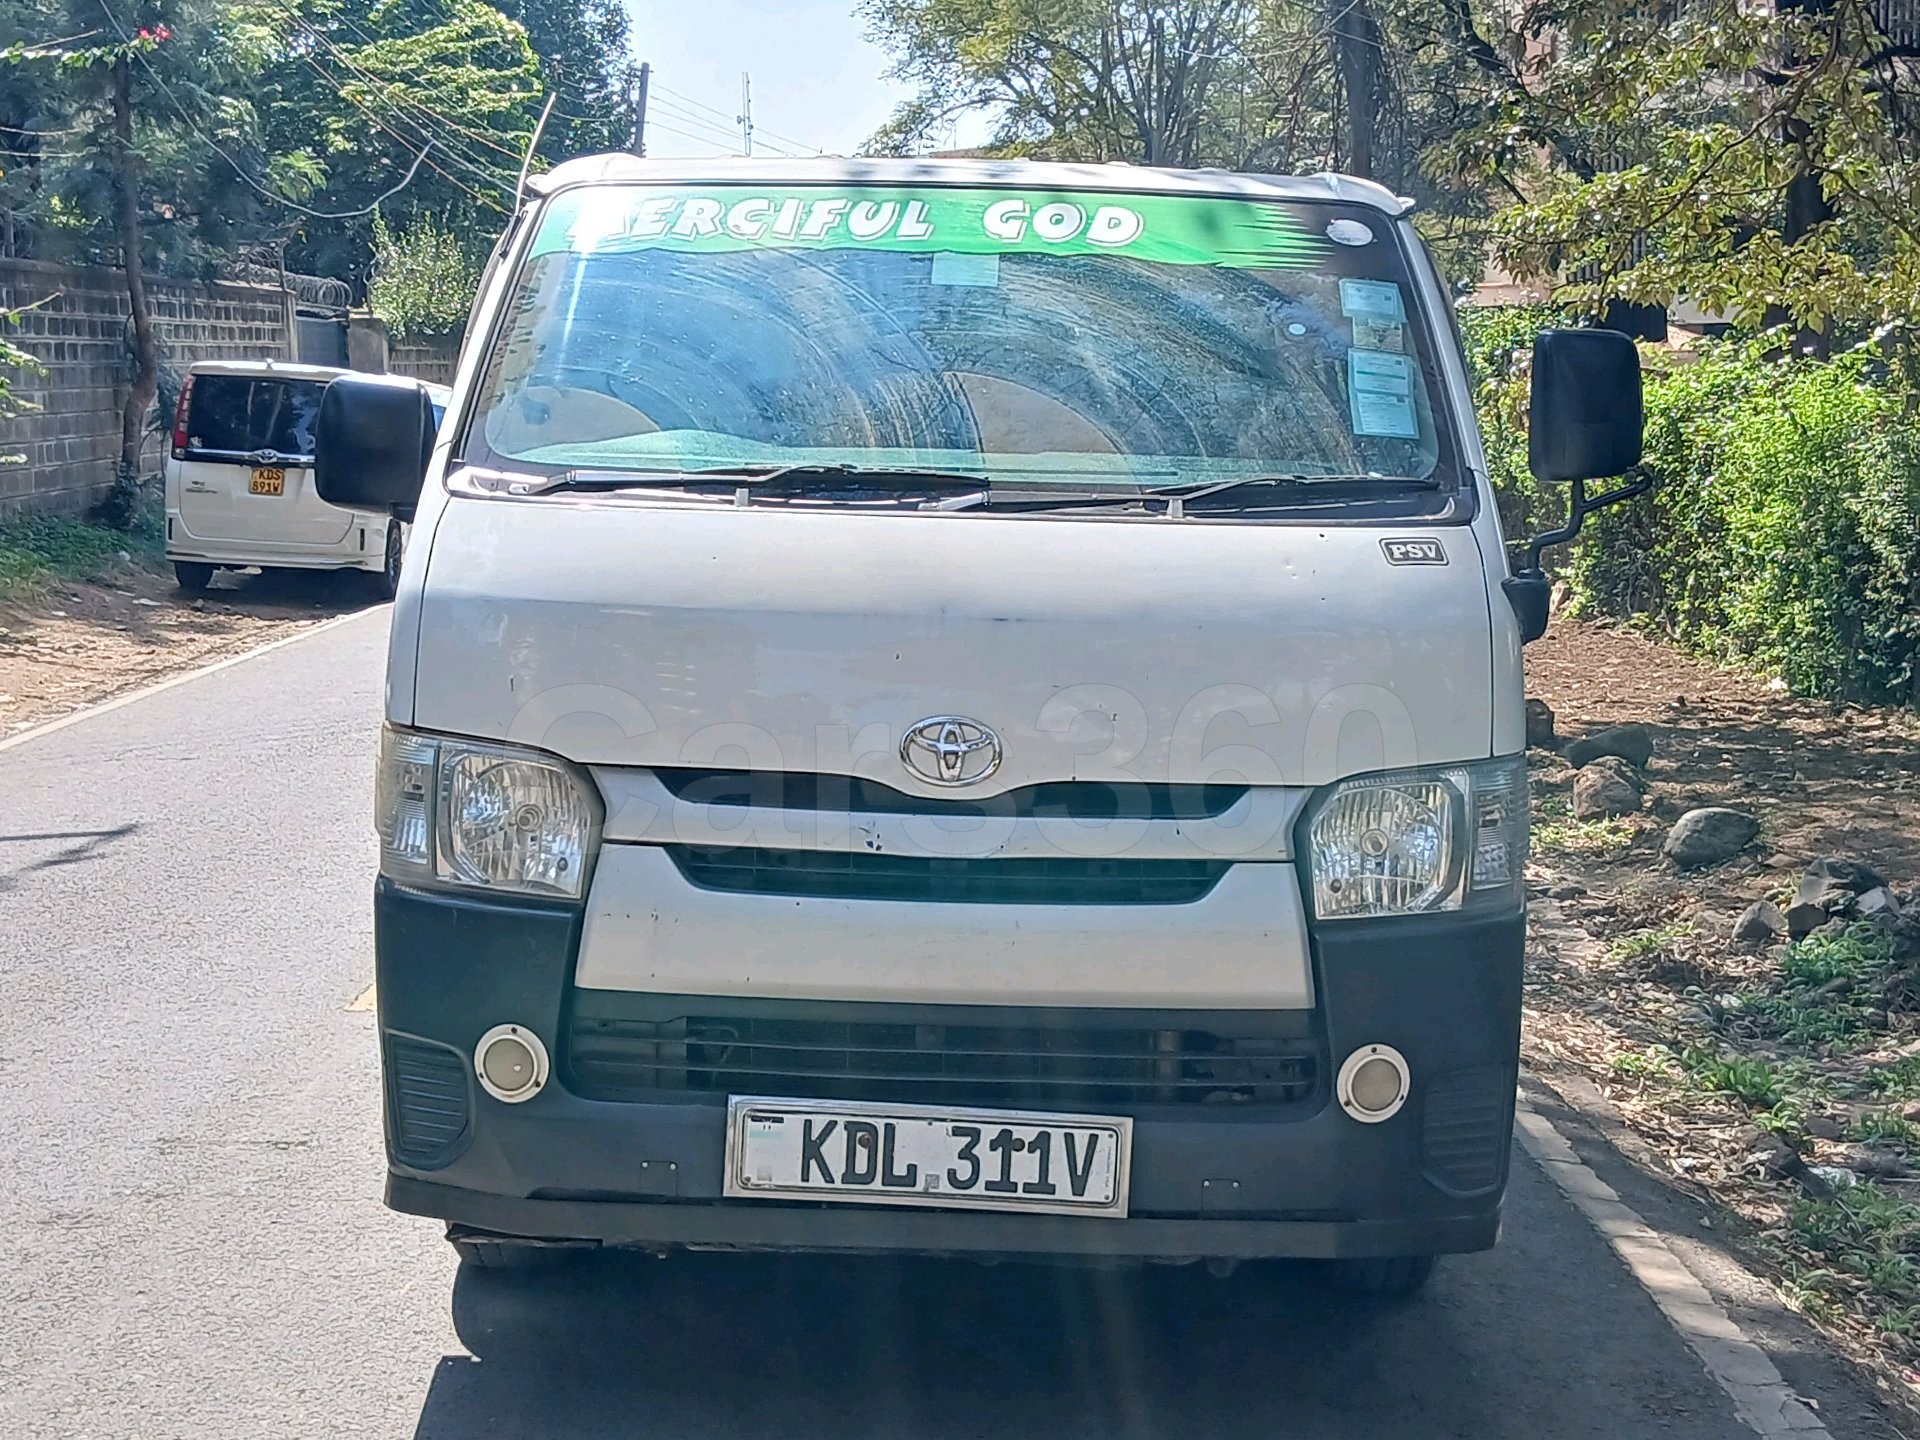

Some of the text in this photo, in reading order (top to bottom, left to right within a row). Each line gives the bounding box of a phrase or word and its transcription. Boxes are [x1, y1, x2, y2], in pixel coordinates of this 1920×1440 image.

[982, 199, 1145, 247] GOD
[259, 469, 282, 480] KDS
[1388, 543, 1437, 559] PSV
[801, 1119, 918, 1188] KDL
[946, 1125, 1099, 1197] 311V
